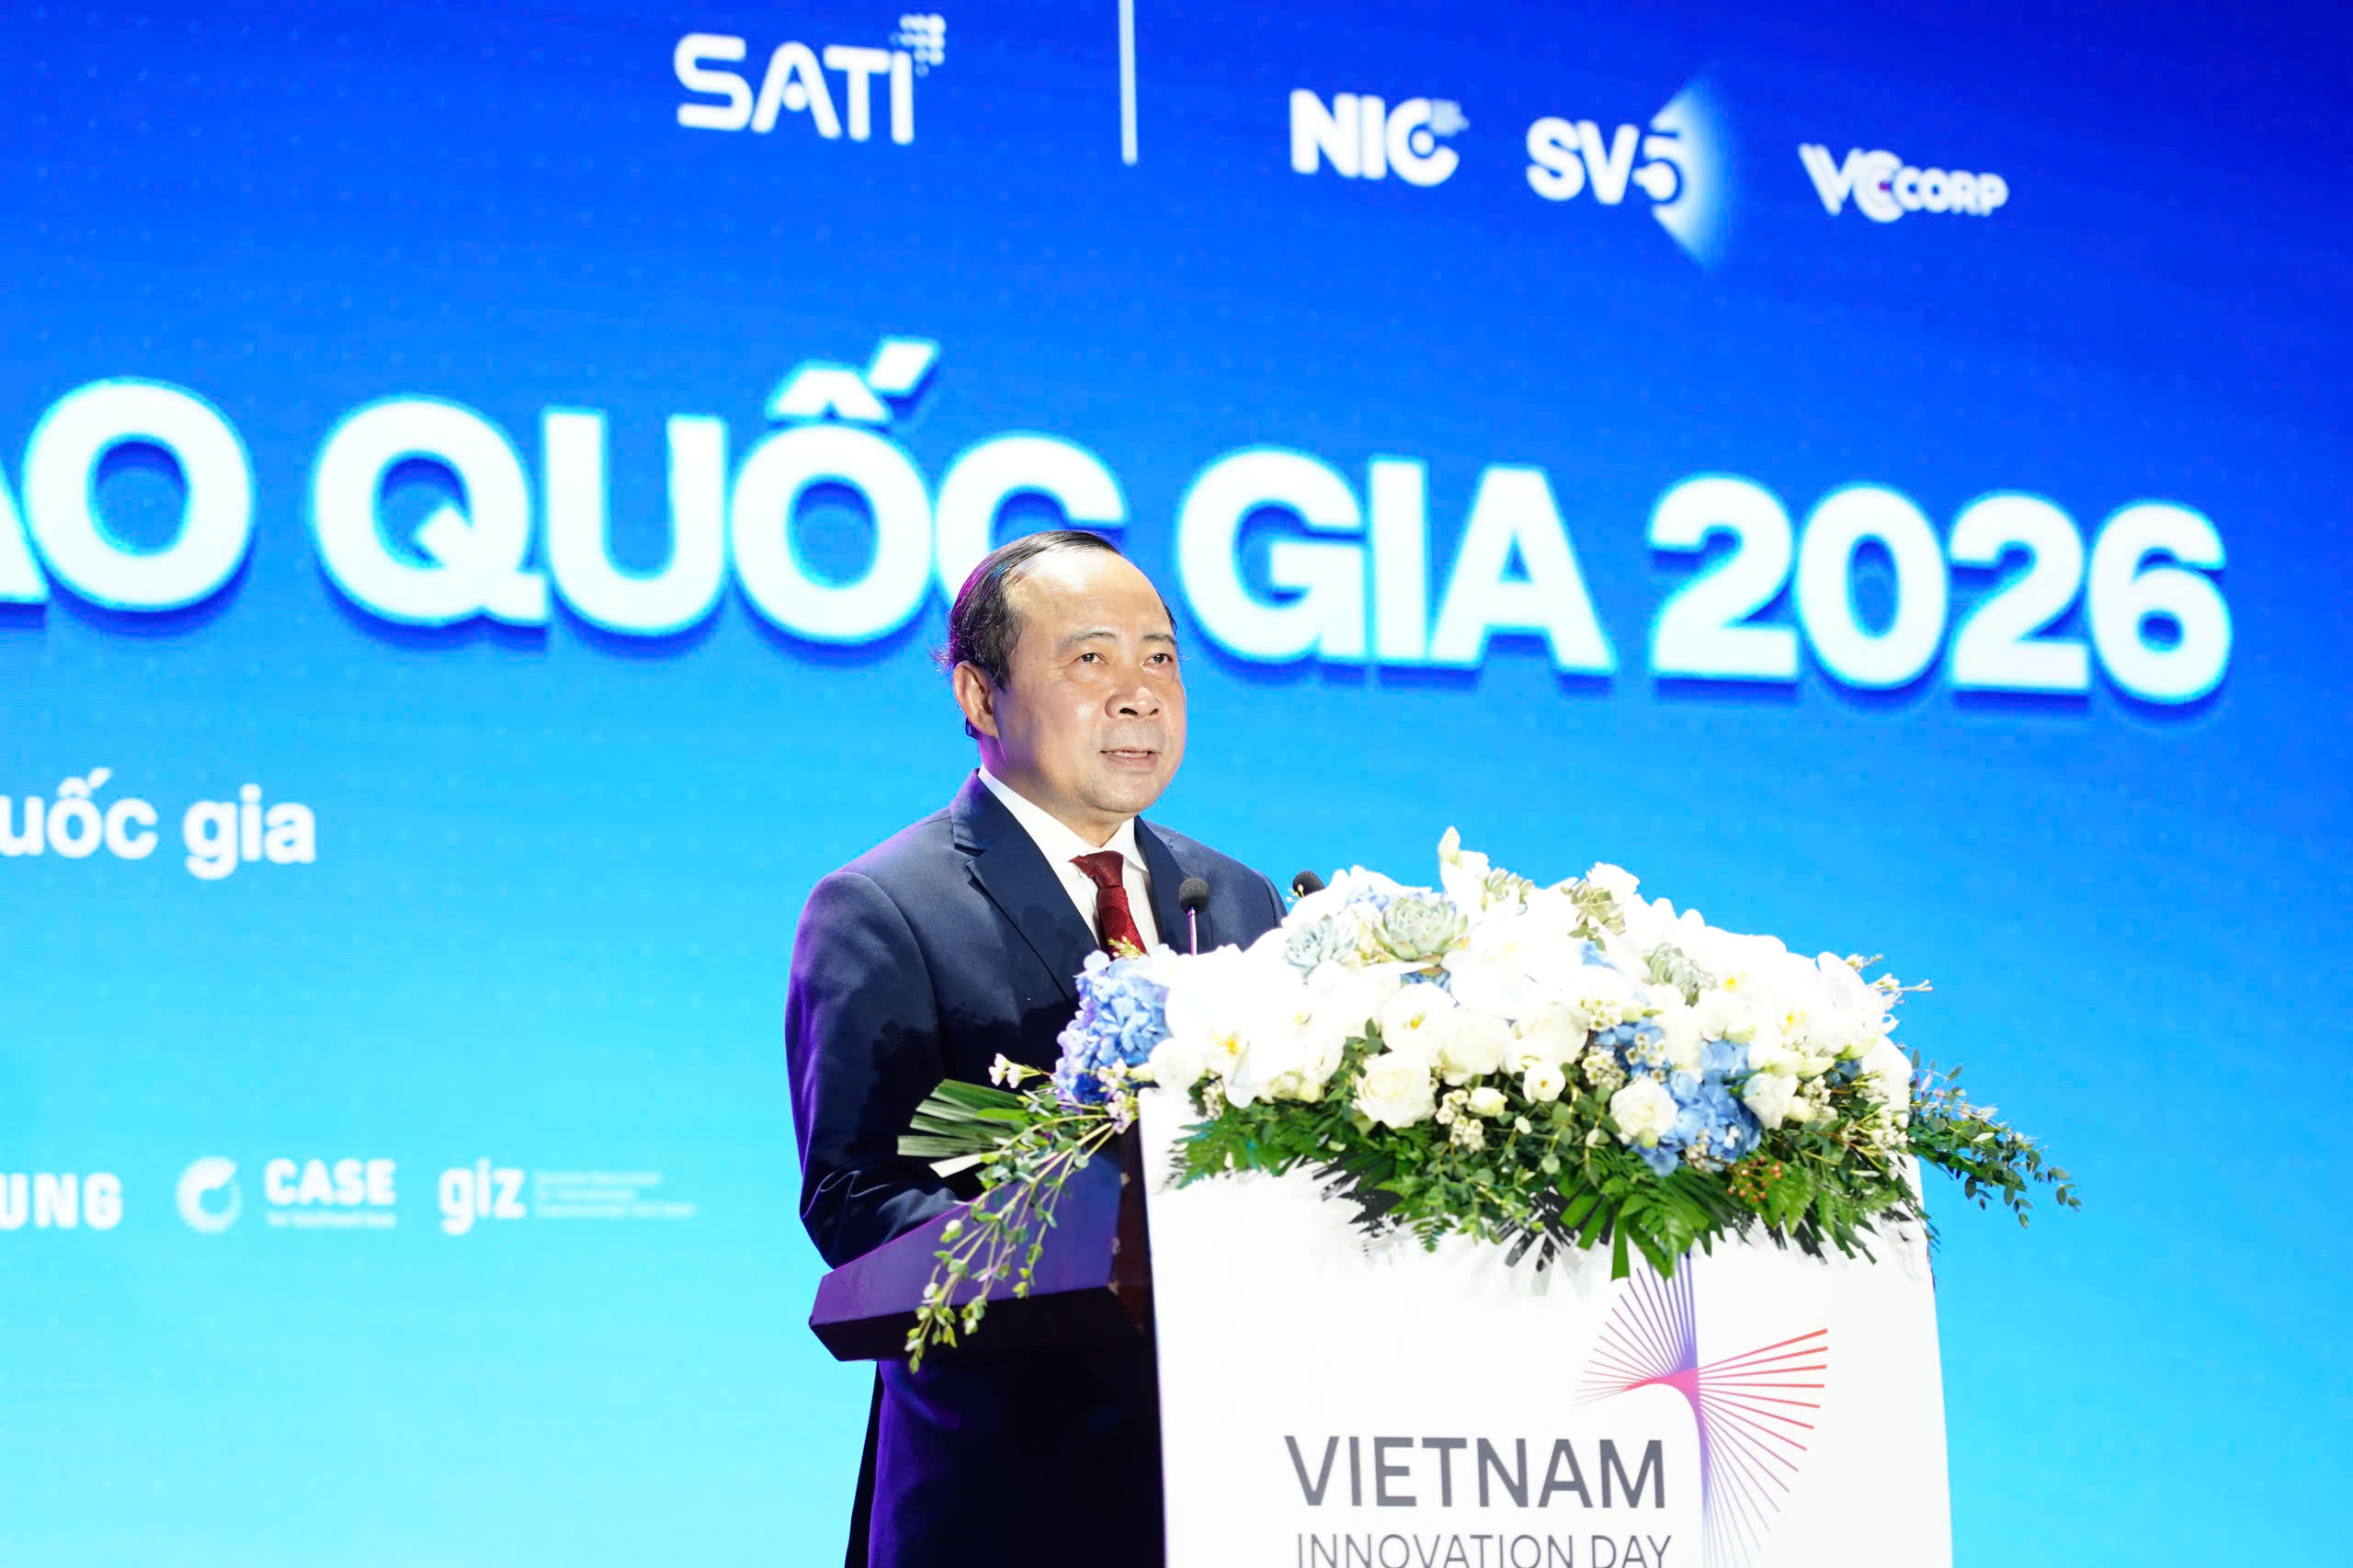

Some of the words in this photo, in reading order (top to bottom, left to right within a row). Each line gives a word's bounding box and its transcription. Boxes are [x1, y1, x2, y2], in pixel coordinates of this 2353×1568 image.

[674, 32, 915, 145] SATI
[1290, 88, 1461, 187] NIC
[1526, 116, 1689, 208] SV5
[311, 338, 1127, 645] QUỐC
[1177, 447, 1614, 675] GIA
[1647, 474, 2234, 705] 2026
[0, 767, 158, 859] uốc
[184, 783, 316, 880] gia
[0, 1172, 123, 1230] UNG
[264, 1158, 397, 1207] CASE
[438, 1157, 528, 1234] giz
[1283, 1435, 1665, 1508] VIETNAM
[1297, 1533, 1574, 1568] INNOVATION
[1590, 1534, 1672, 1568] DAY
